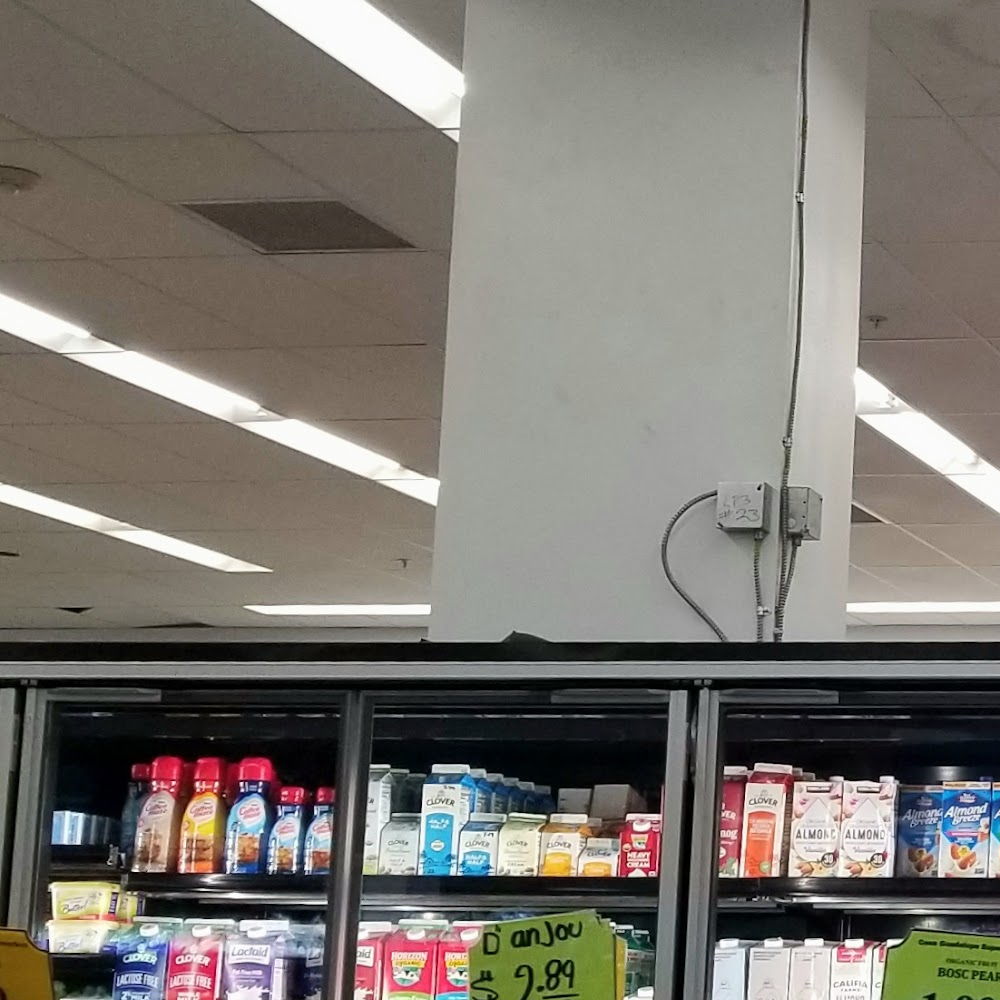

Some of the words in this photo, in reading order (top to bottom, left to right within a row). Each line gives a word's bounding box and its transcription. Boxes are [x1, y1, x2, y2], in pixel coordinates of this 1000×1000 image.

[426, 798, 455, 807] CLOVER
[748, 797, 778, 807] CLOVER
[944, 803, 989, 818] Almond
[845, 829, 885, 840] ALMOND
[546, 842, 572, 850] CLOVER
[627, 852, 651, 860] HEAVY
[918, 939, 937, 947] Casa
[231, 945, 267, 957] Lactaid
[123, 953, 158, 966] CLOVER
[175, 954, 211, 966] CLOVER
[937, 967, 970, 980] BOSC
[833, 980, 867, 988] CALIFIA
